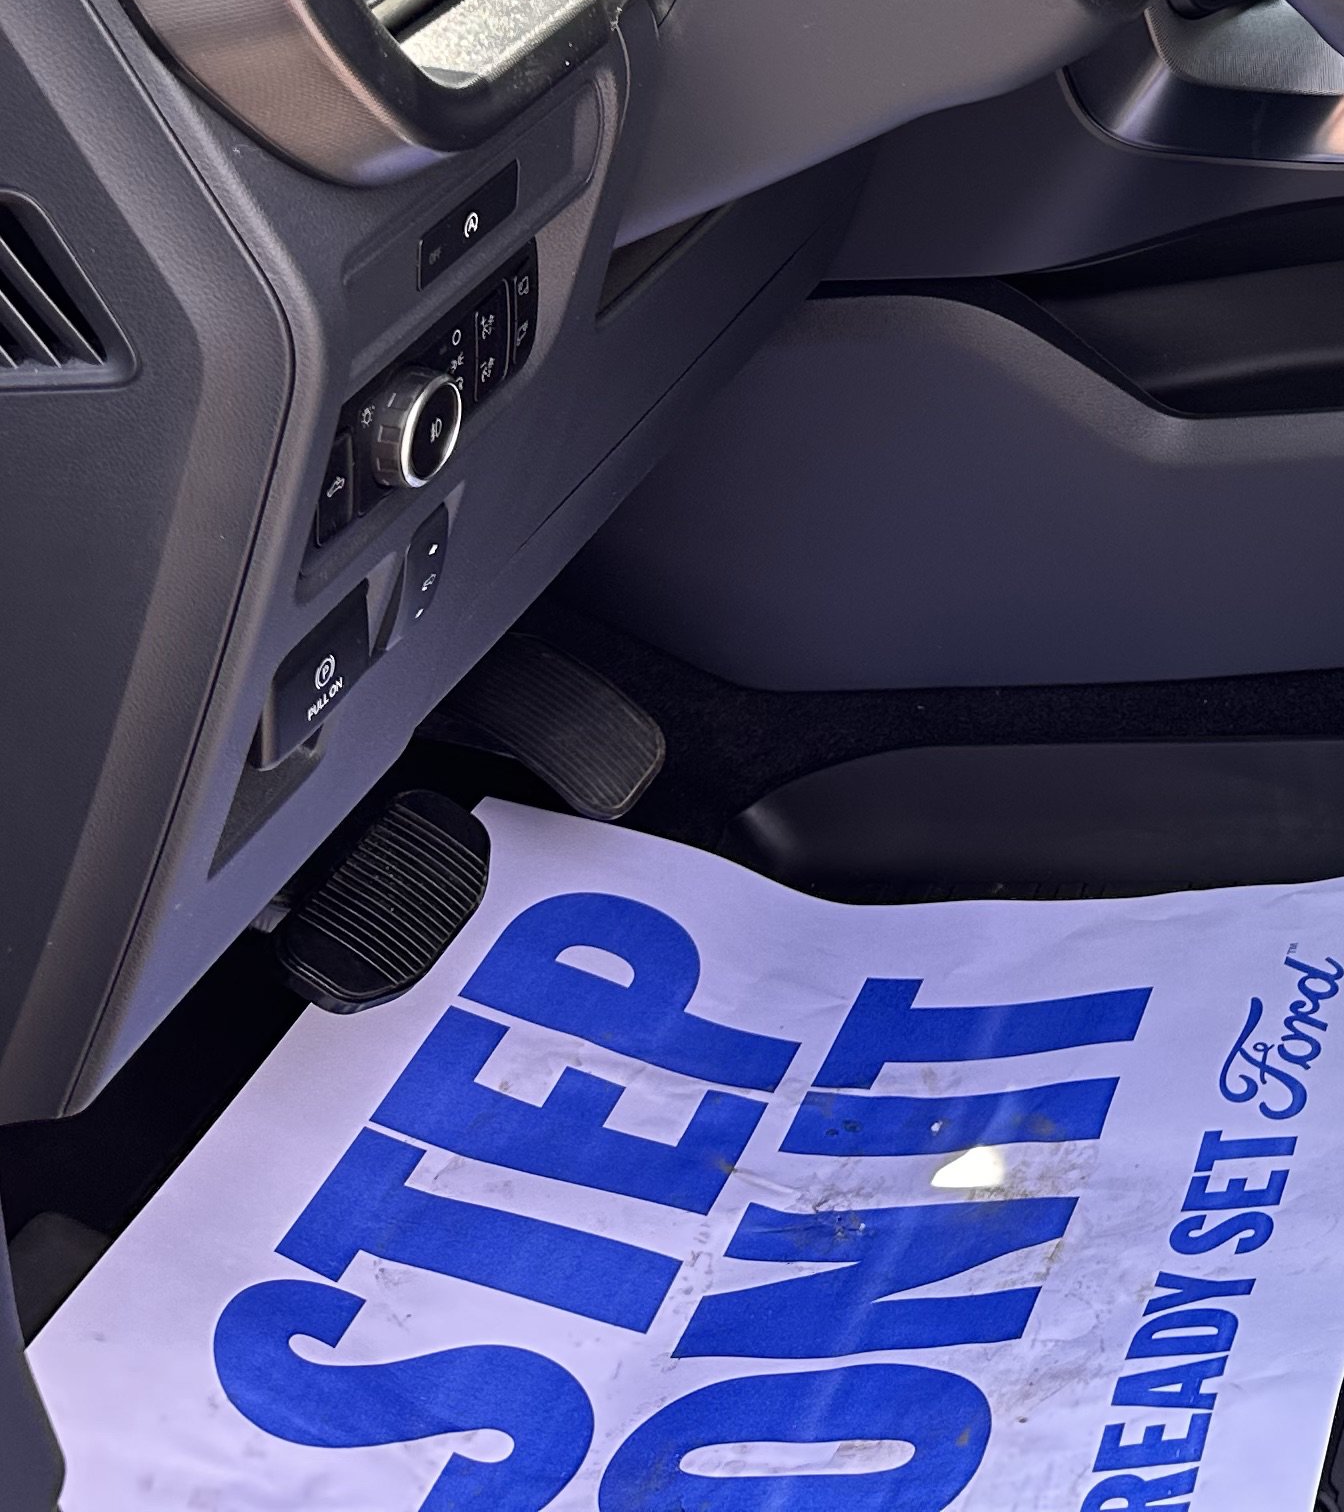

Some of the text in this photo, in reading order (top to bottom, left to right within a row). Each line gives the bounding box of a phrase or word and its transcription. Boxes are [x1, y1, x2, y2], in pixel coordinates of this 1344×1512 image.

[307, 676, 344, 722] PULL ON
[1219, 956, 1344, 1120] Ford
[213, 891, 801, 1512] STEP
[598, 977, 1154, 1512] ON IT
[1169, 1130, 1297, 1255] SET
[1079, 1271, 1257, 1512] READY
